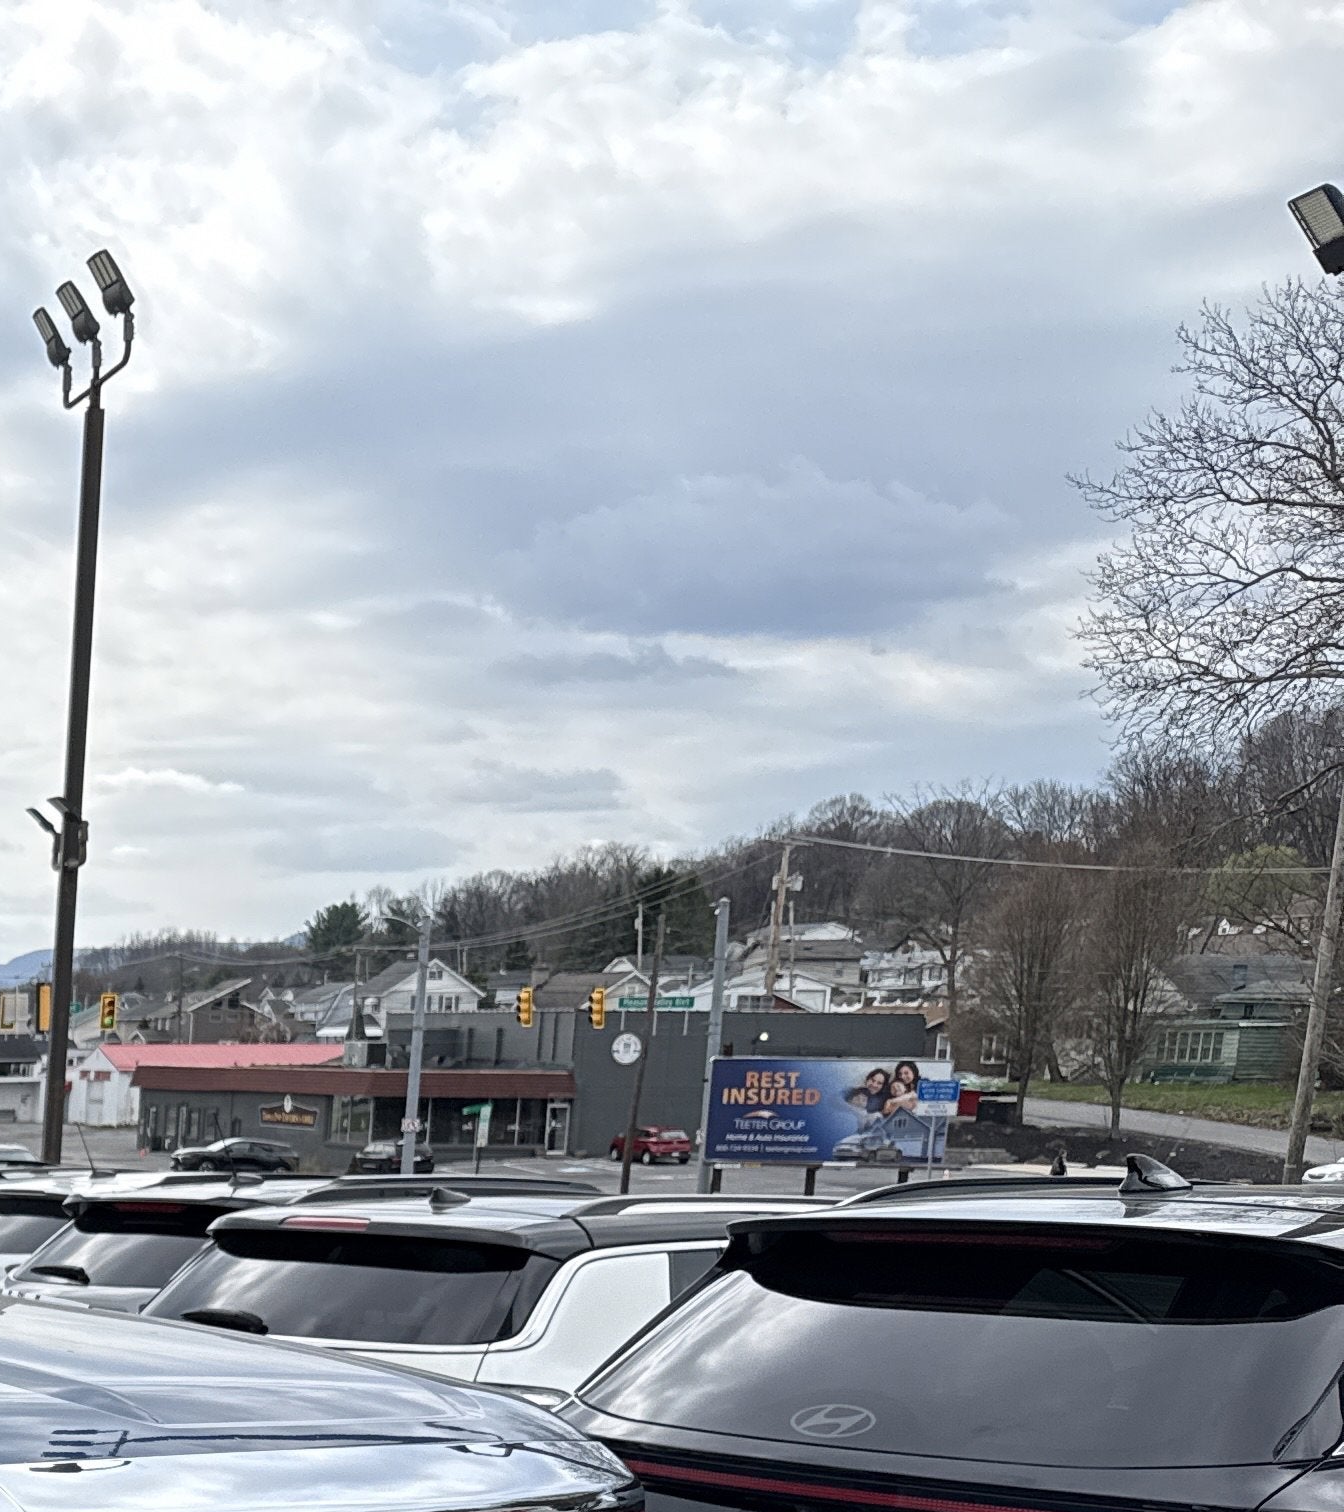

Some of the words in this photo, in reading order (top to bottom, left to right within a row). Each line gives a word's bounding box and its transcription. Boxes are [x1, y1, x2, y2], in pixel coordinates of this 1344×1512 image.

[745, 1071, 801, 1089] REST
[722, 1087, 822, 1106] INSURED
[769, 1118, 806, 1131] GROUP
